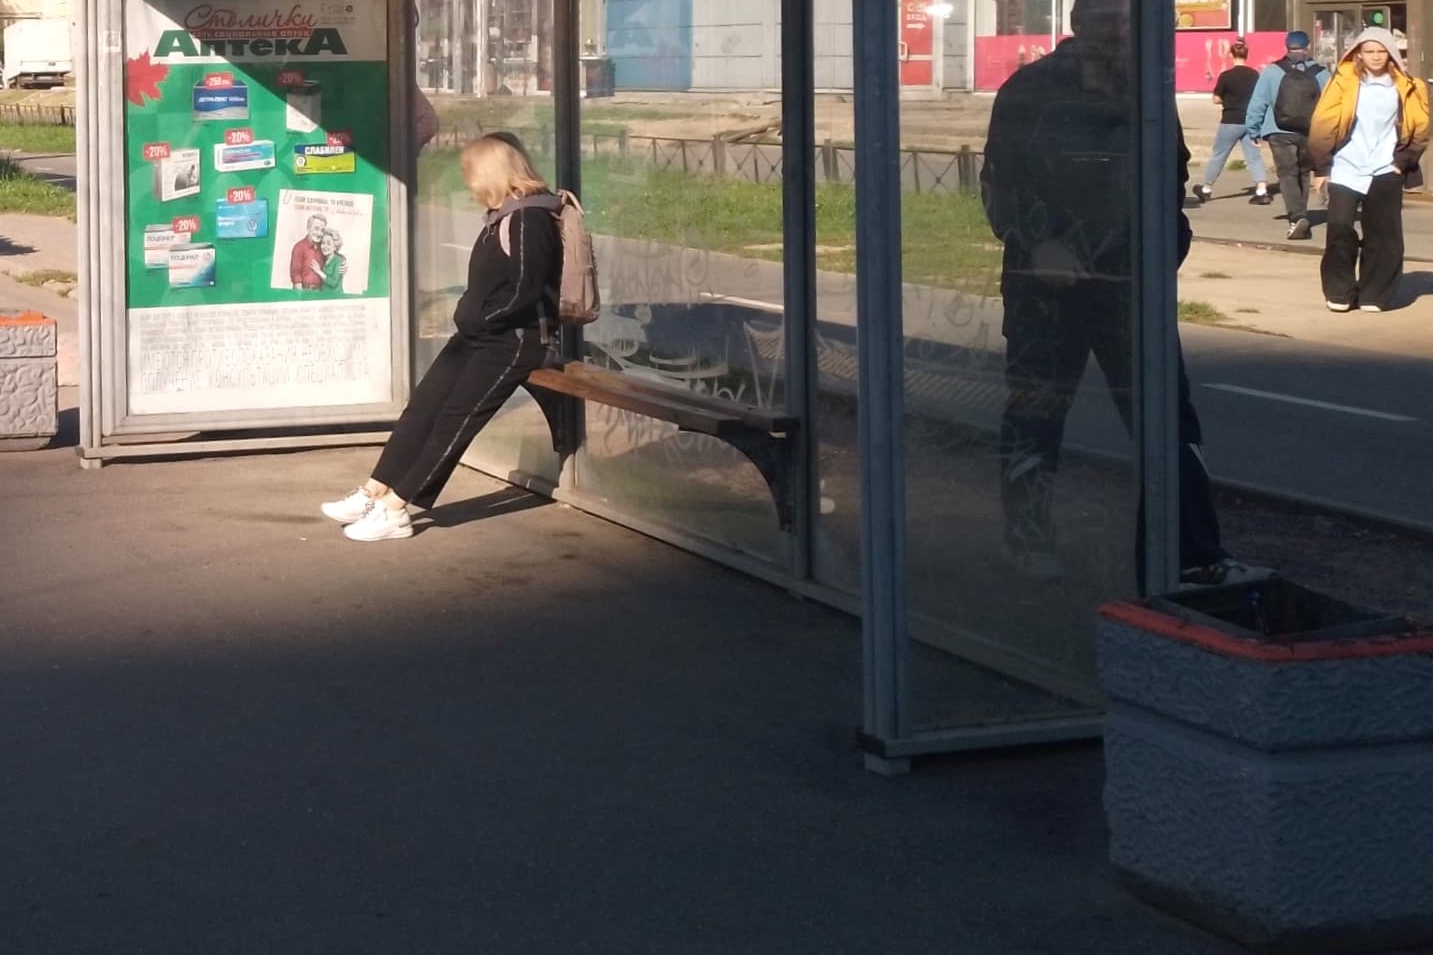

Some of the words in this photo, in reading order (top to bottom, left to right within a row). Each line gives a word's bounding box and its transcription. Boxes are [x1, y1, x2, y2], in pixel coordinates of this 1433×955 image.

[228, 131, 250, 143] -20%
[146, 145, 168, 158] -20%
[229, 189, 251, 202] -20%
[175, 219, 197, 231] -20%
